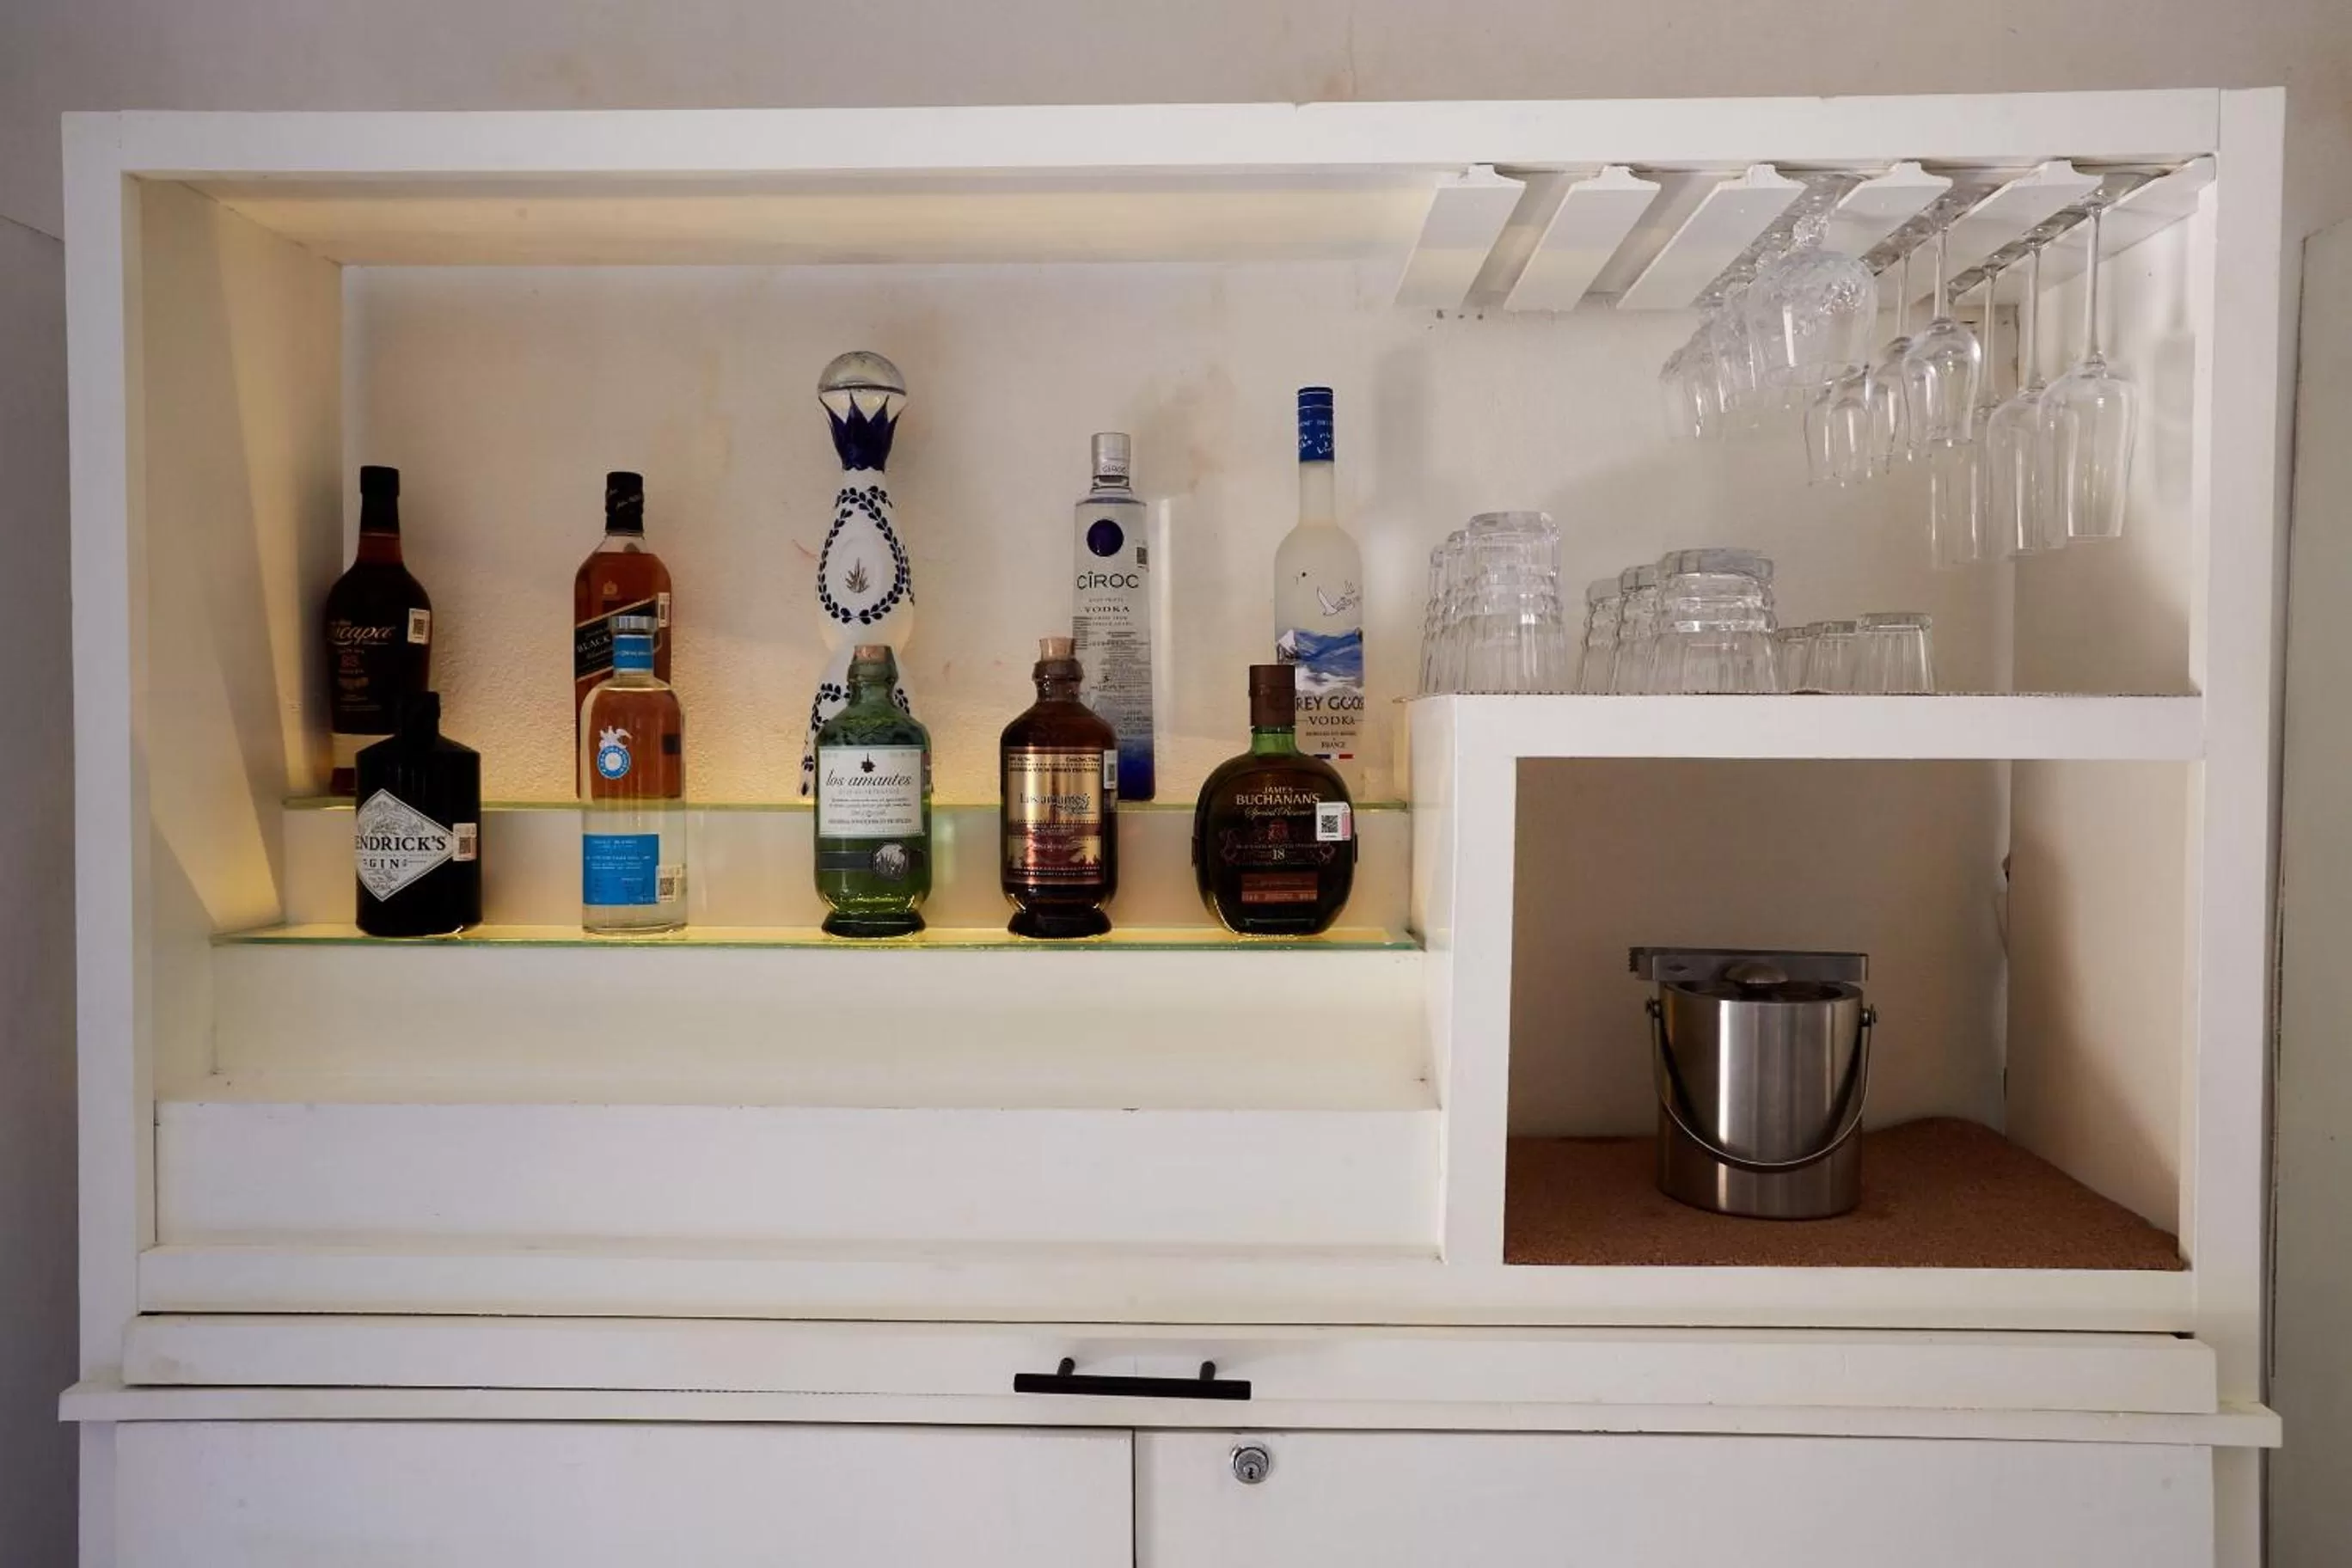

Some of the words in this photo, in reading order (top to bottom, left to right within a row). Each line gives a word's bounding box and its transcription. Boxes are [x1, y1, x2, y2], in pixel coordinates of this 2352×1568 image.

[1076, 571, 1139, 590] CÎROC
[1295, 695, 1323, 712] REY
[1308, 715, 1356, 726] VODKA
[826, 769, 845, 787] los
[848, 773, 912, 787] amantes
[355, 835, 446, 852] ENDRICK'S
[1272, 848, 1285, 861] 18
[370, 859, 400, 869] GIN
